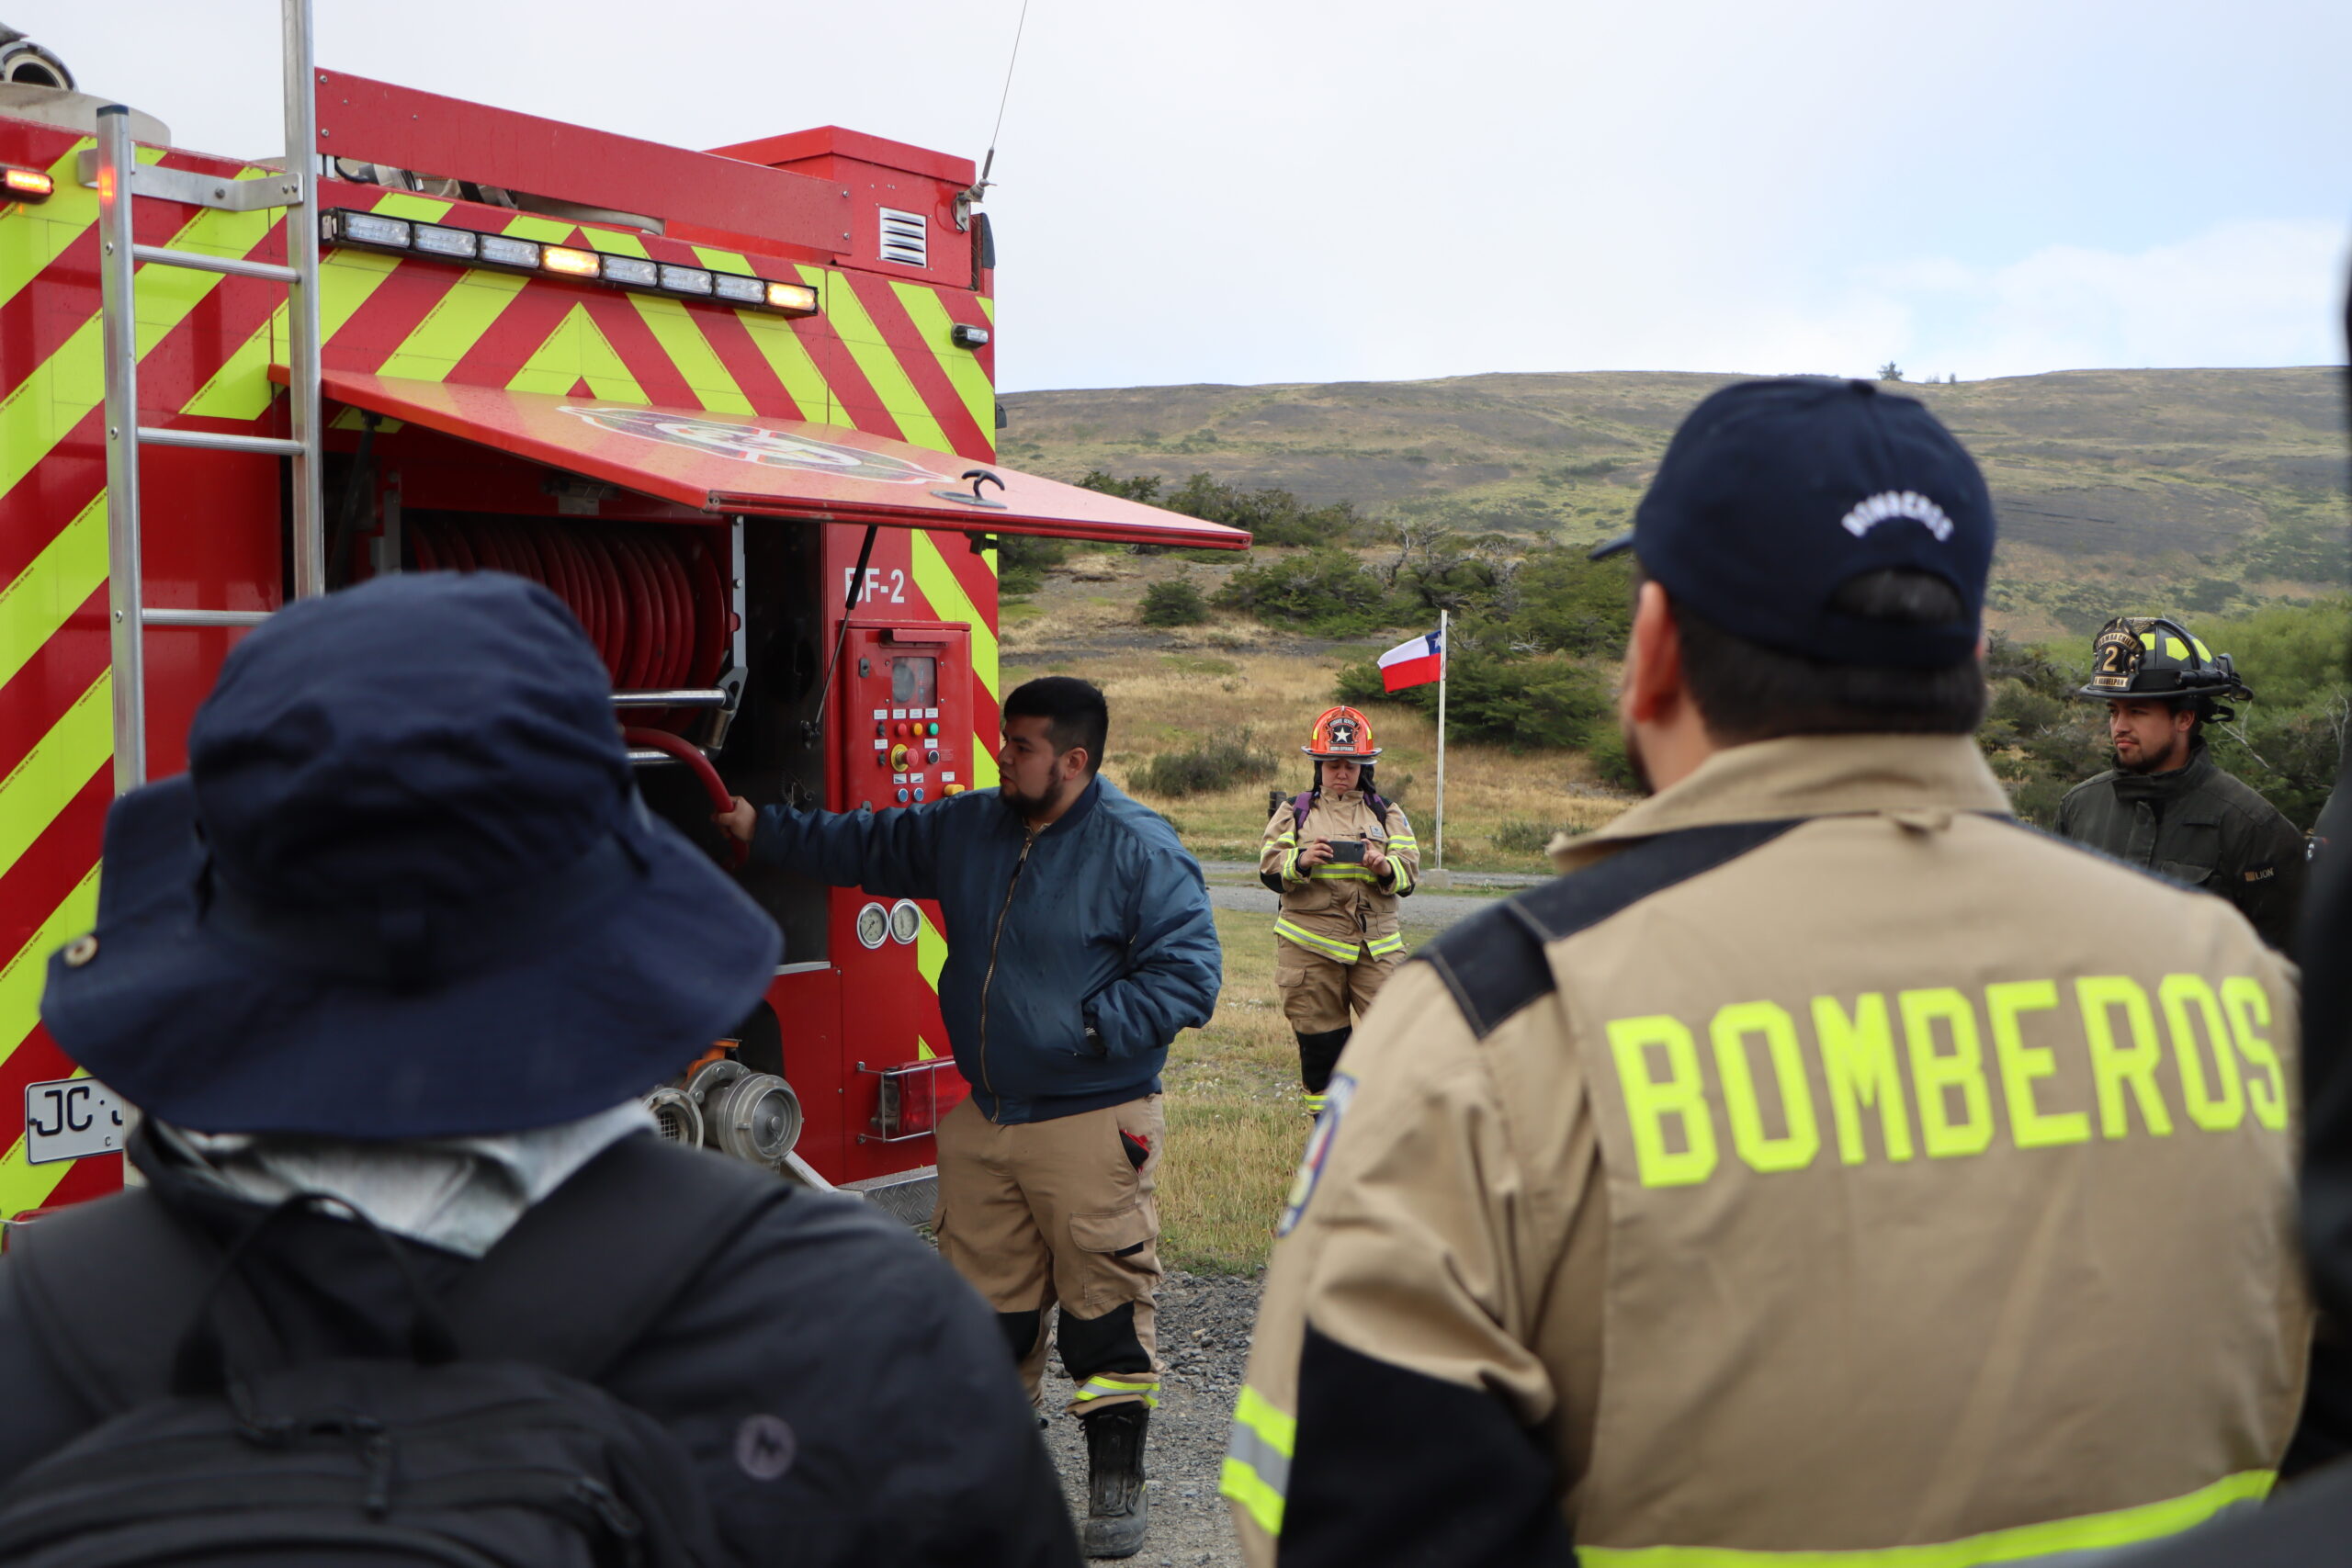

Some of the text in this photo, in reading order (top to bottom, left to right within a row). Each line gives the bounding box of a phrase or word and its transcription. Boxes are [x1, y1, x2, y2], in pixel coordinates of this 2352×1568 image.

[2102, 645, 2119, 671] 2
[2256, 867, 2274, 880] LION
[1606, 973, 2288, 1188] BOMBEROS
